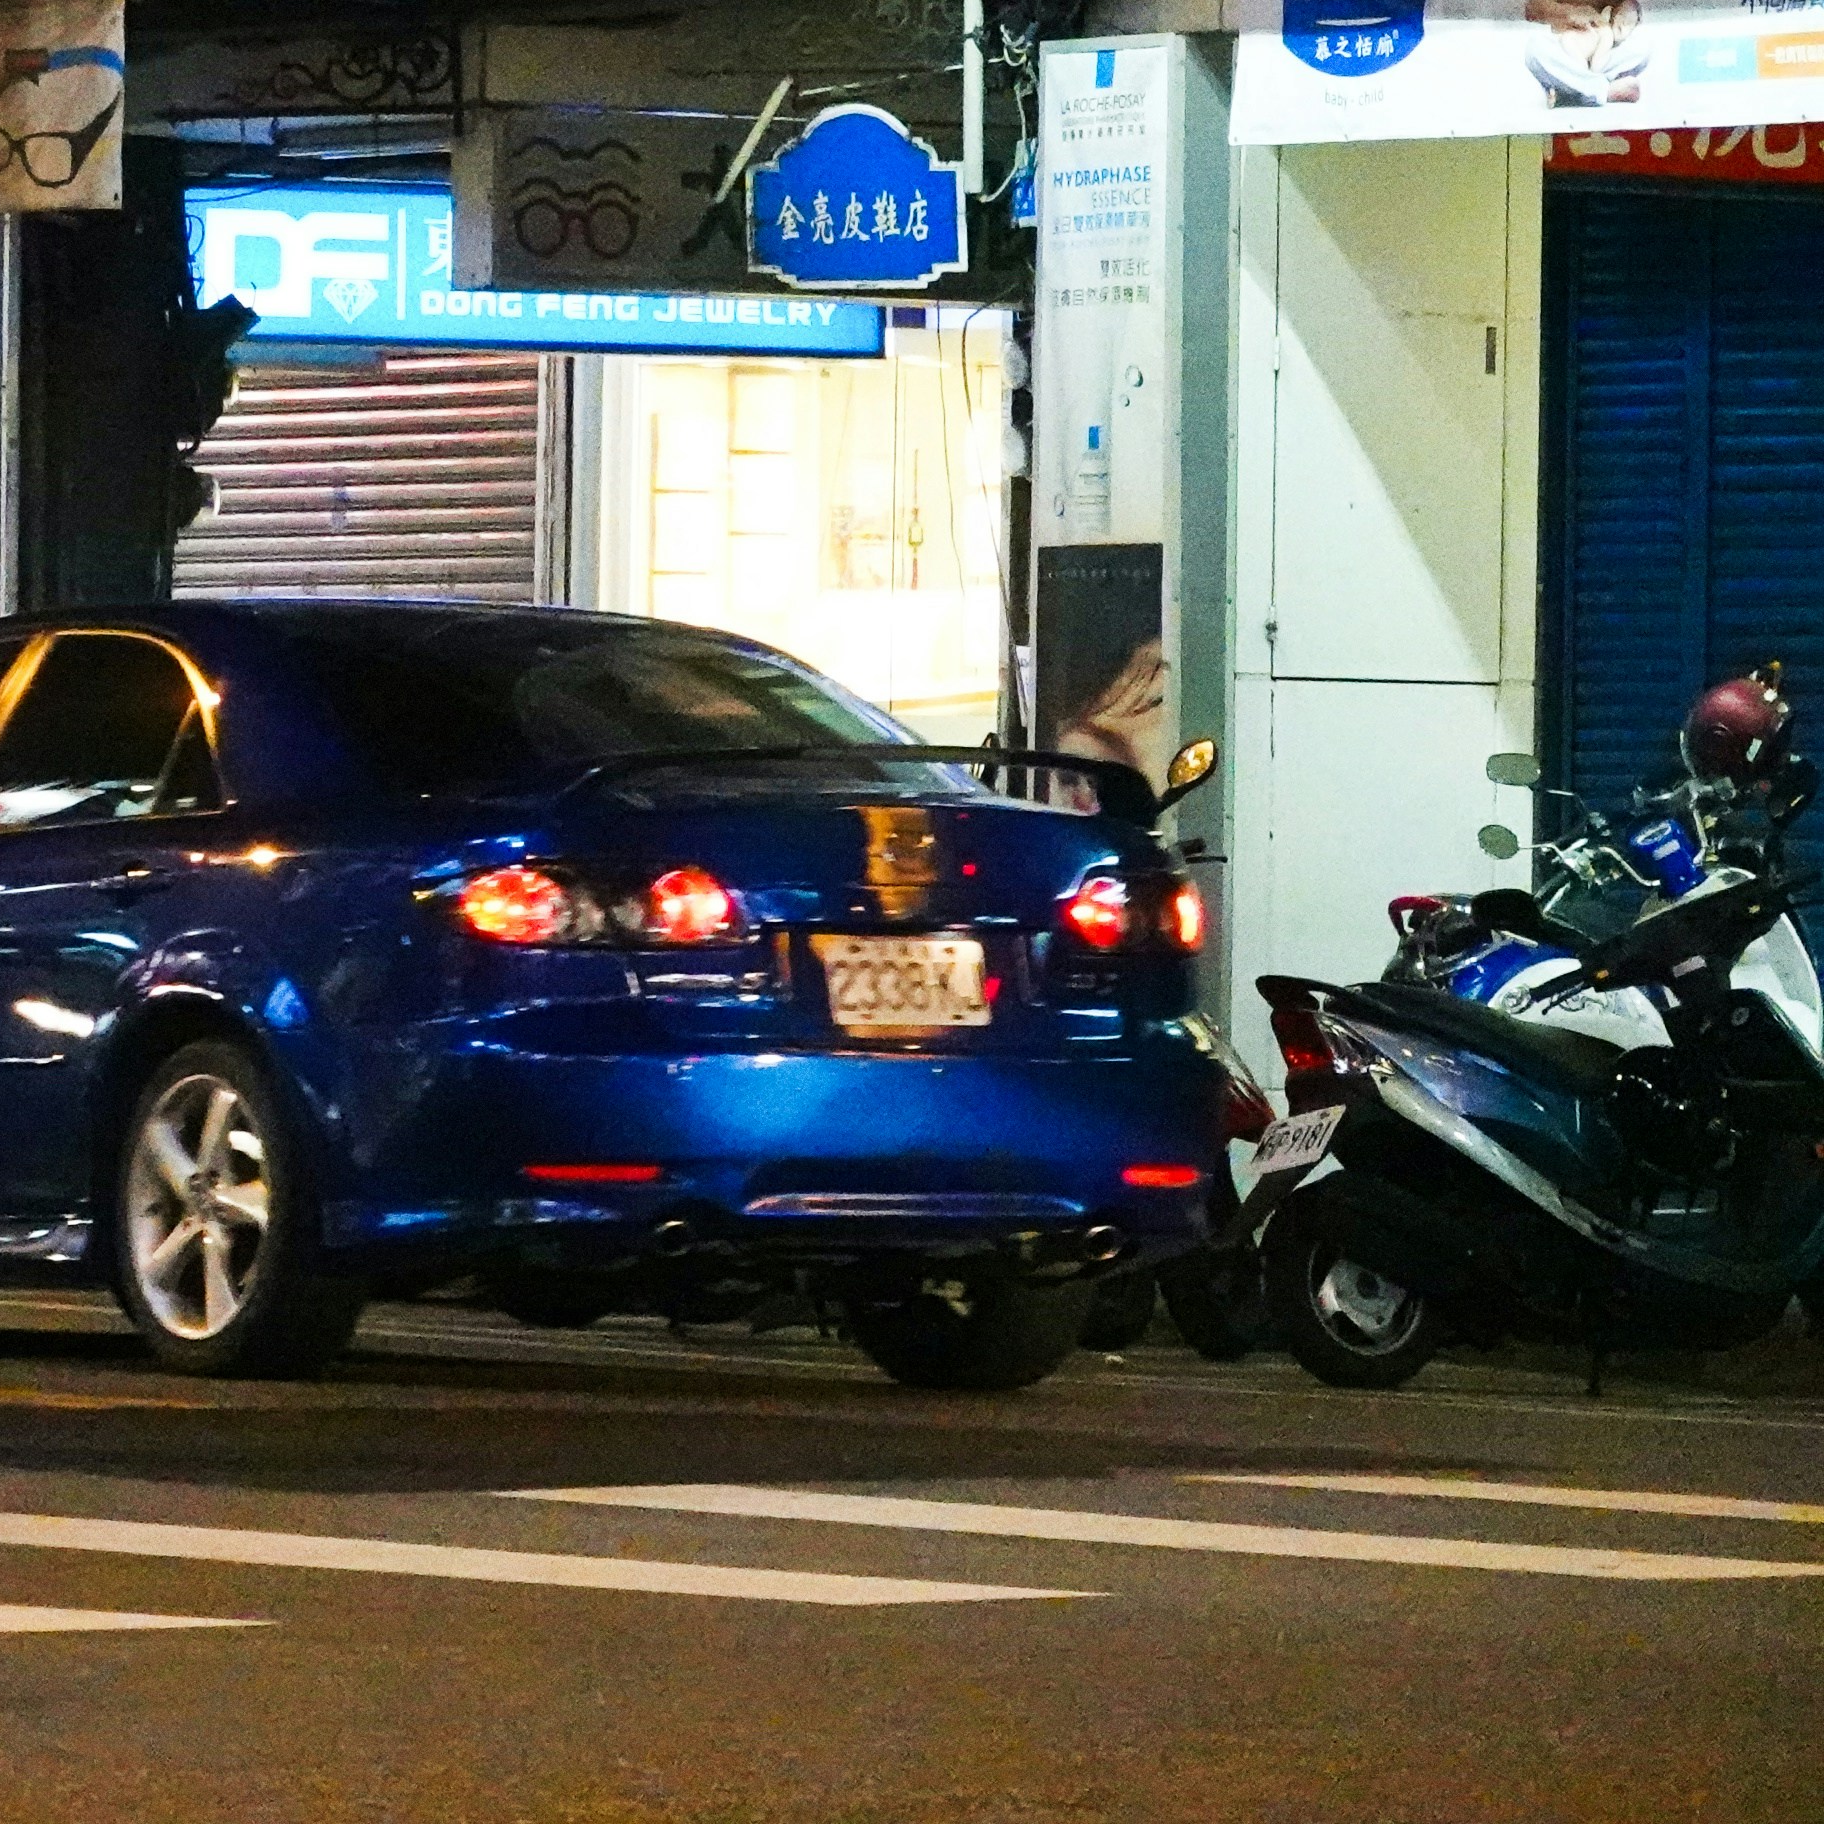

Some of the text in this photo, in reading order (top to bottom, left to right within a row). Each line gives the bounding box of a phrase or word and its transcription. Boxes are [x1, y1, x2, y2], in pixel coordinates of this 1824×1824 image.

[1053, 165, 1152, 189] HYDRAPHASE
[1092, 186, 1151, 210] ESSENCE
[776, 189, 930, 245] 金亮皮鞋店
[419, 289, 838, 328] DONG FENG JEWELRY
